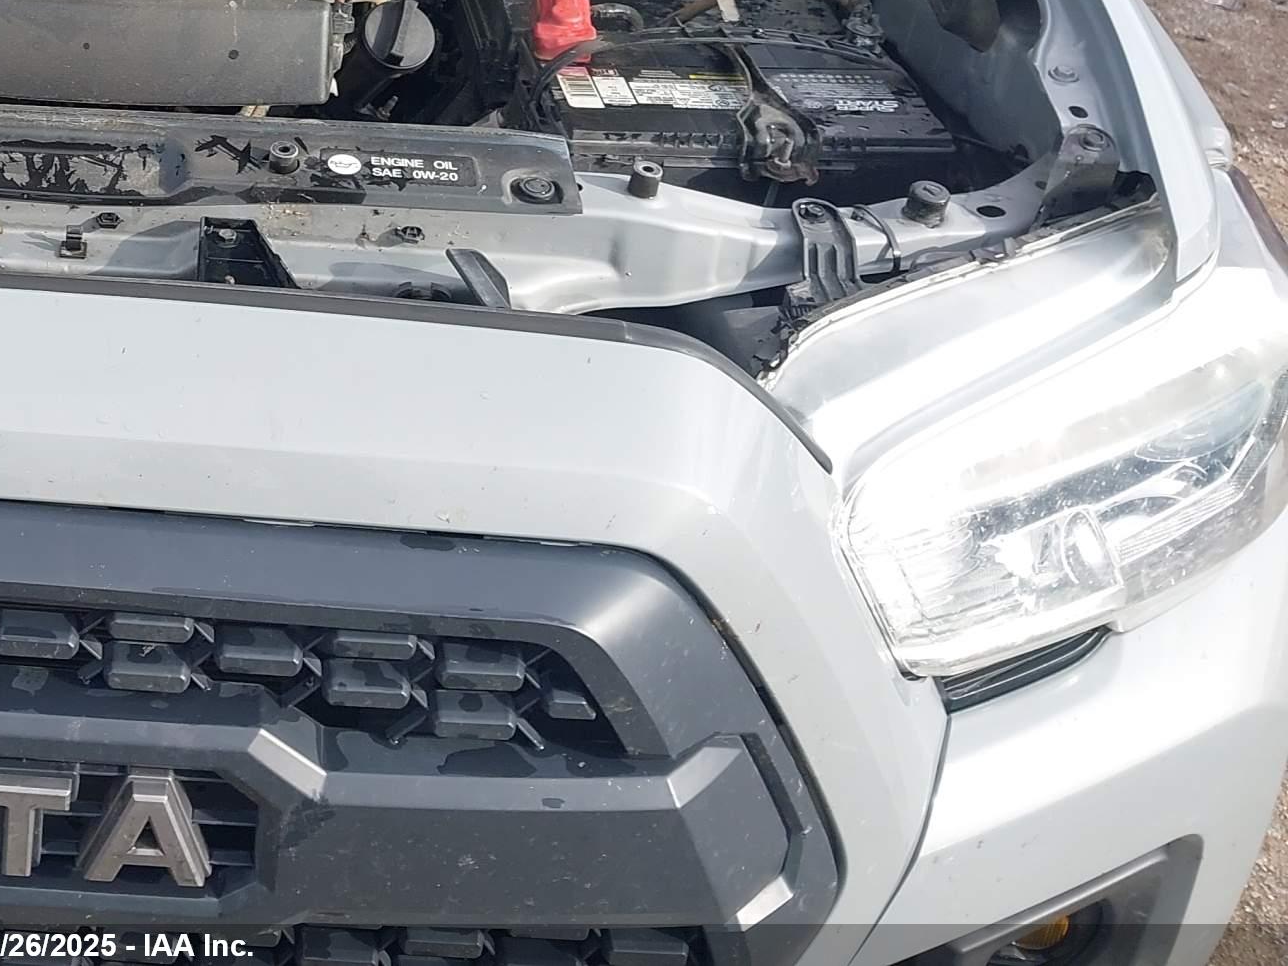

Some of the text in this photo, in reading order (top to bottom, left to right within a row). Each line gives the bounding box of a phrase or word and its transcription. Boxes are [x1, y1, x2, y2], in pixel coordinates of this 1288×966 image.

[833, 99, 899, 108] START
[835, 104, 897, 113] SUPER
[370, 156, 458, 171] ENGINE OIL
[372, 167, 458, 181] SAE 0W-20
